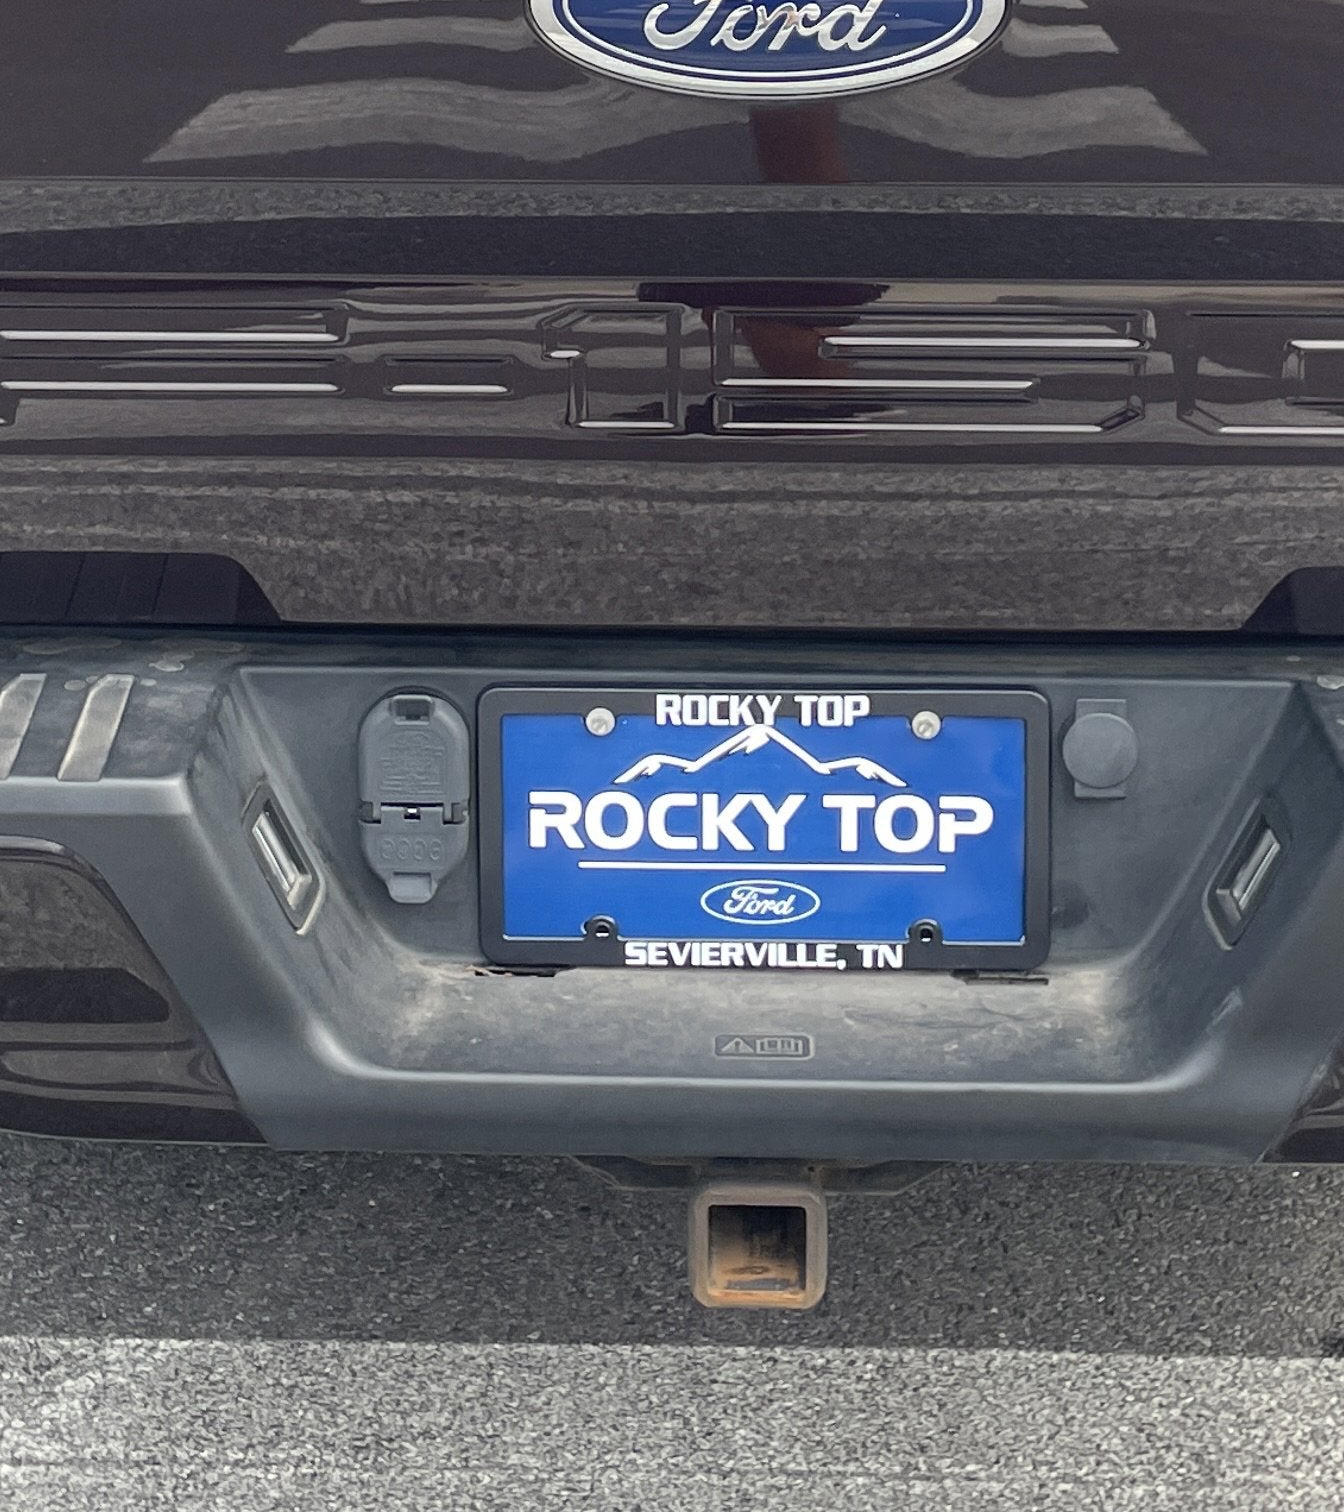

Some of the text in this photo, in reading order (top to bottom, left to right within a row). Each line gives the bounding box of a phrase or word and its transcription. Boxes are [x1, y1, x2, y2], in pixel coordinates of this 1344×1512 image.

[655, 693, 871, 728] ROCKY TOP
[527, 790, 995, 855] ROCKY TOP
[722, 885, 797, 916] Ford
[623, 941, 904, 971] SEVIERVILLE, TN
